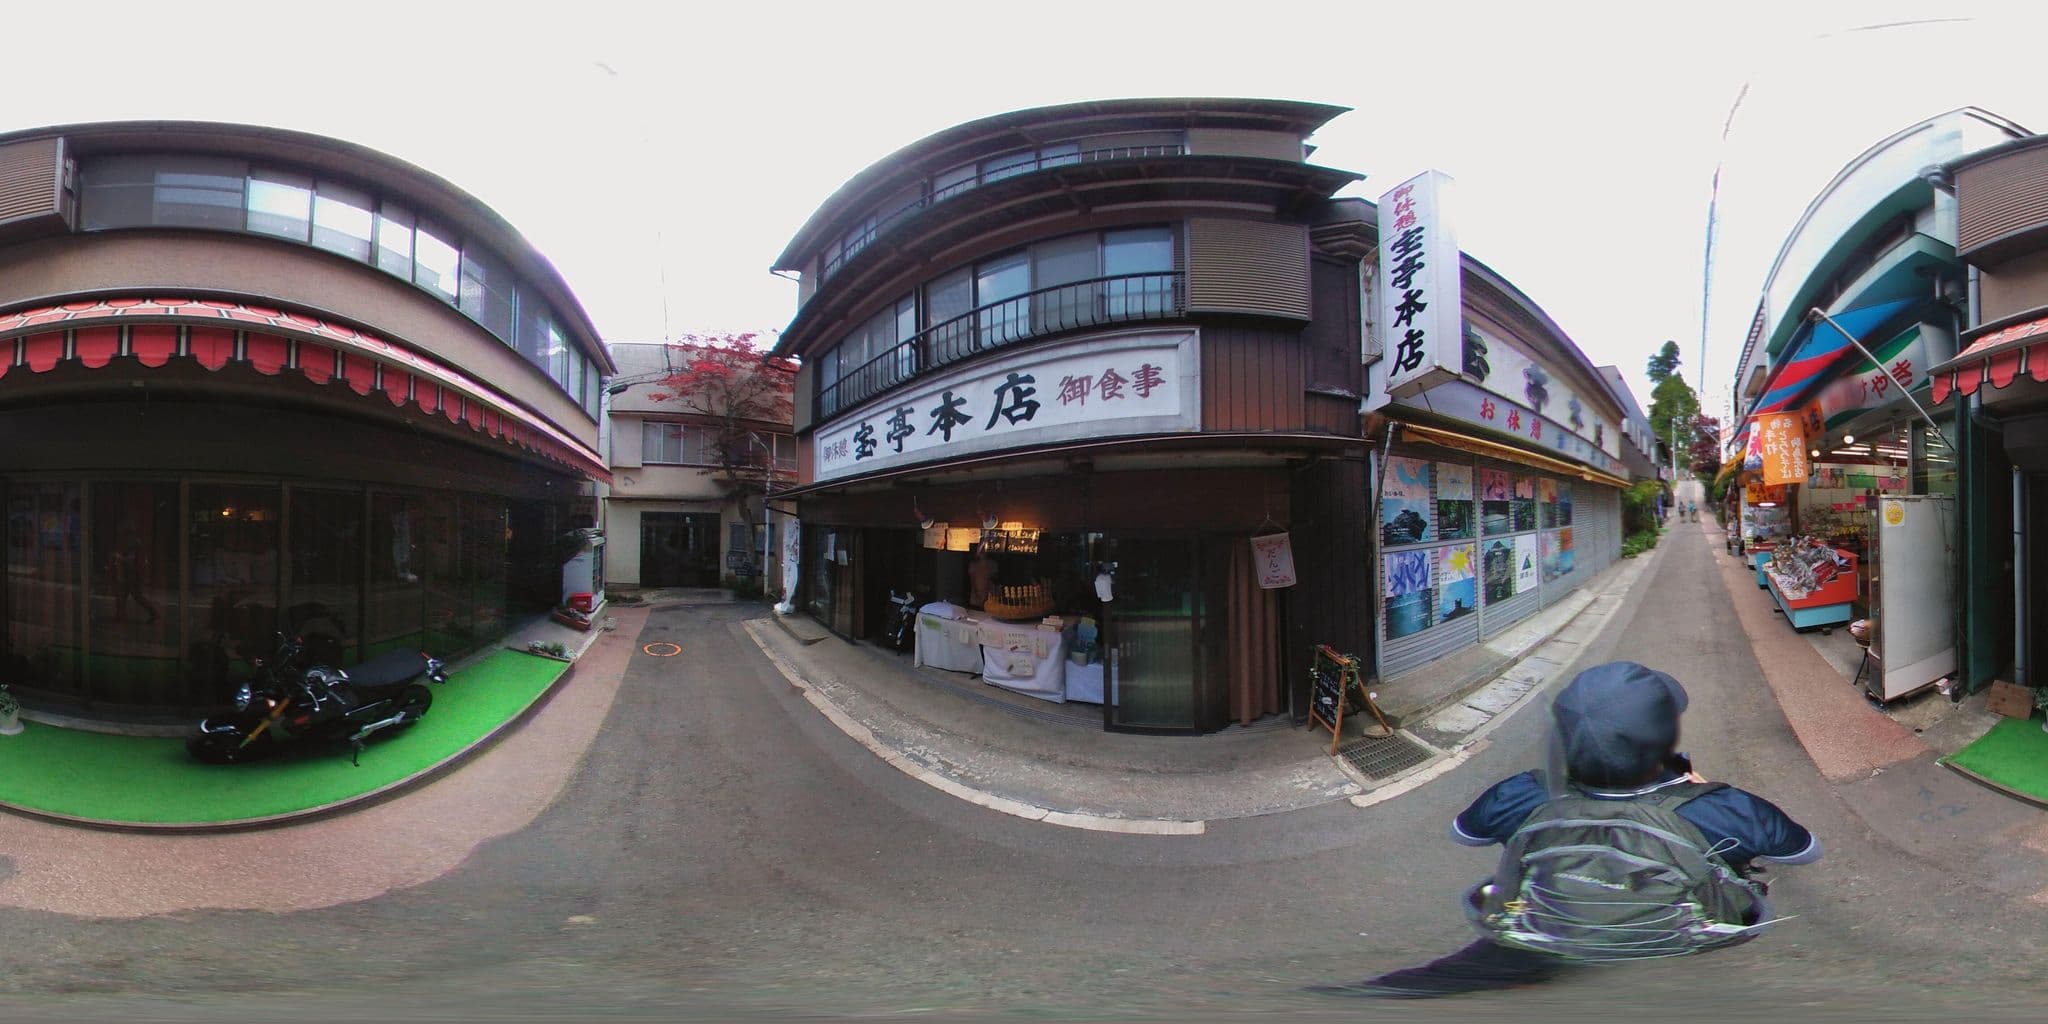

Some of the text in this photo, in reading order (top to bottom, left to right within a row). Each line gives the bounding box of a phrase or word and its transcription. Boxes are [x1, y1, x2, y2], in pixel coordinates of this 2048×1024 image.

[1392, 183, 1417, 232] 御休憩
[1389, 226, 1428, 378] 宝亭本店
[1056, 363, 1166, 407] 御食事
[852, 372, 1042, 461] 宝亭本店
[1480, 397, 1544, 441] お休憩
